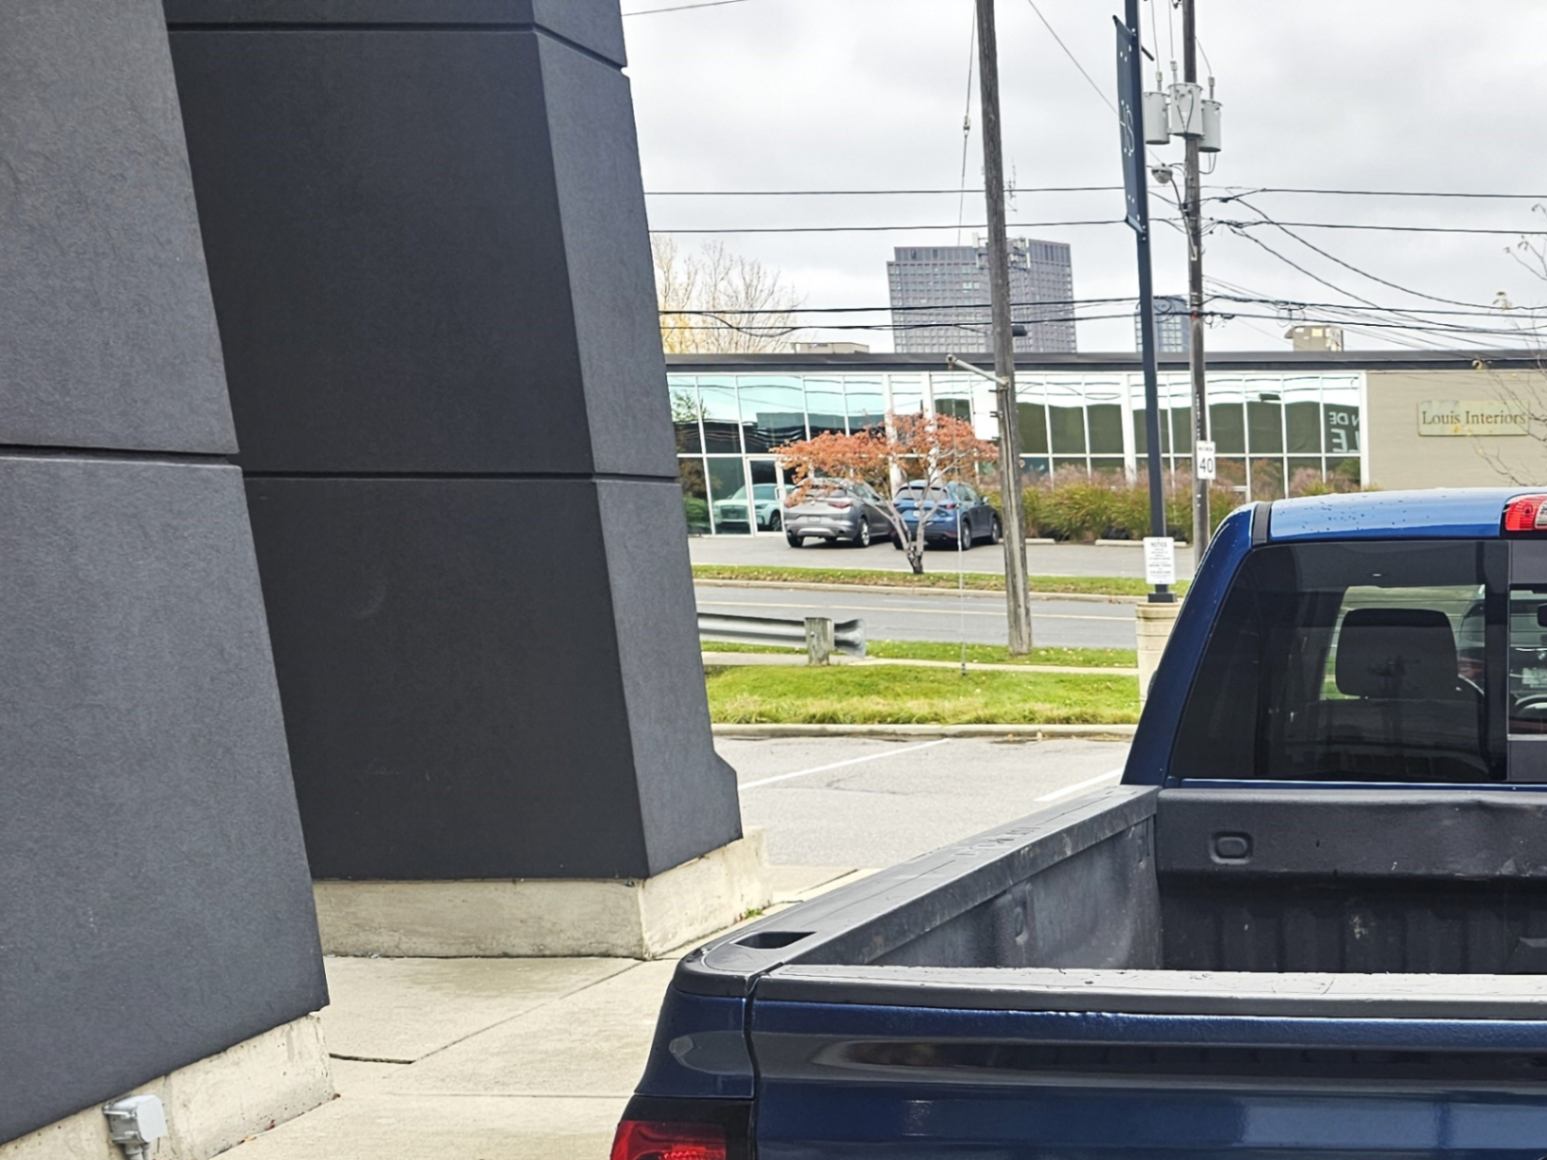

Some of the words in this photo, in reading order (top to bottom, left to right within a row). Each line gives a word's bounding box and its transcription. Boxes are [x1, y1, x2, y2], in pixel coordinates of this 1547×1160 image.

[1421, 410, 1460, 425] Louis
[1465, 409, 1527, 425] Interiors
[1199, 457, 1214, 474] 40
